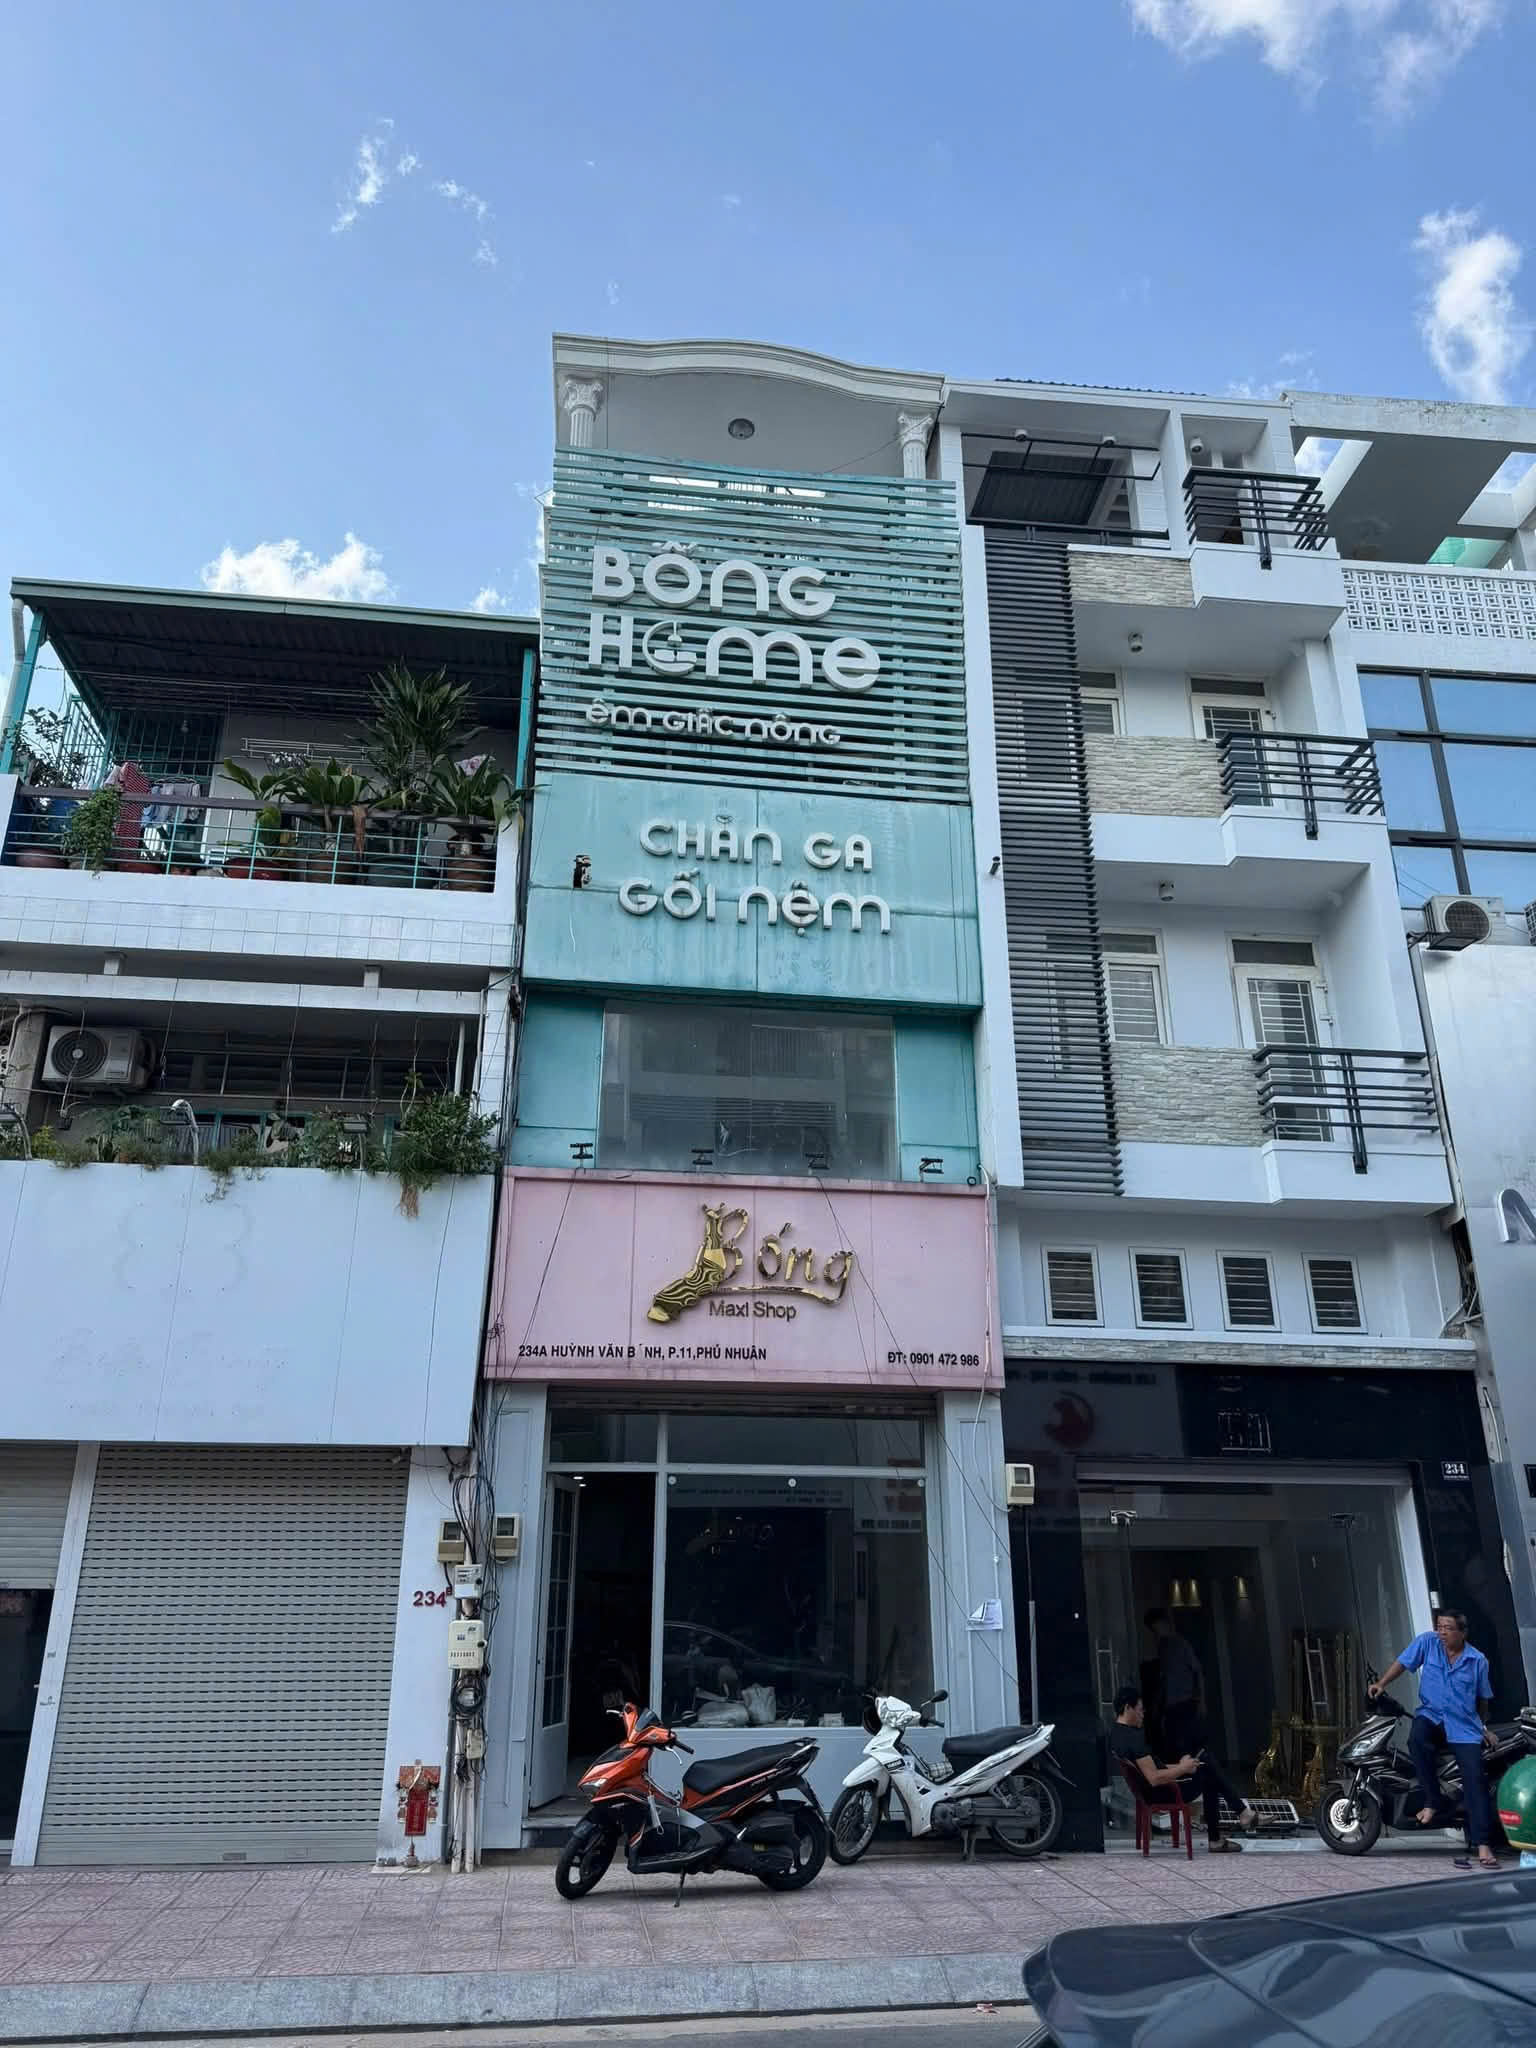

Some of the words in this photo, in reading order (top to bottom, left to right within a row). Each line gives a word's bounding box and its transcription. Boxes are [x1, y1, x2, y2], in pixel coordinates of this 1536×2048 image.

[803, 831, 873, 874] GA
[753, 1301, 797, 1322] Shop
[518, 1344, 547, 1357] 234A
[551, 1342, 595, 1358] HUỲNH
[599, 1343, 624, 1359] VĂN
[887, 1351, 907, 1365] ĐT:
[910, 1352, 934, 1365] 0901
[938, 1353, 957, 1366] 472
[960, 1354, 980, 1367] 986
